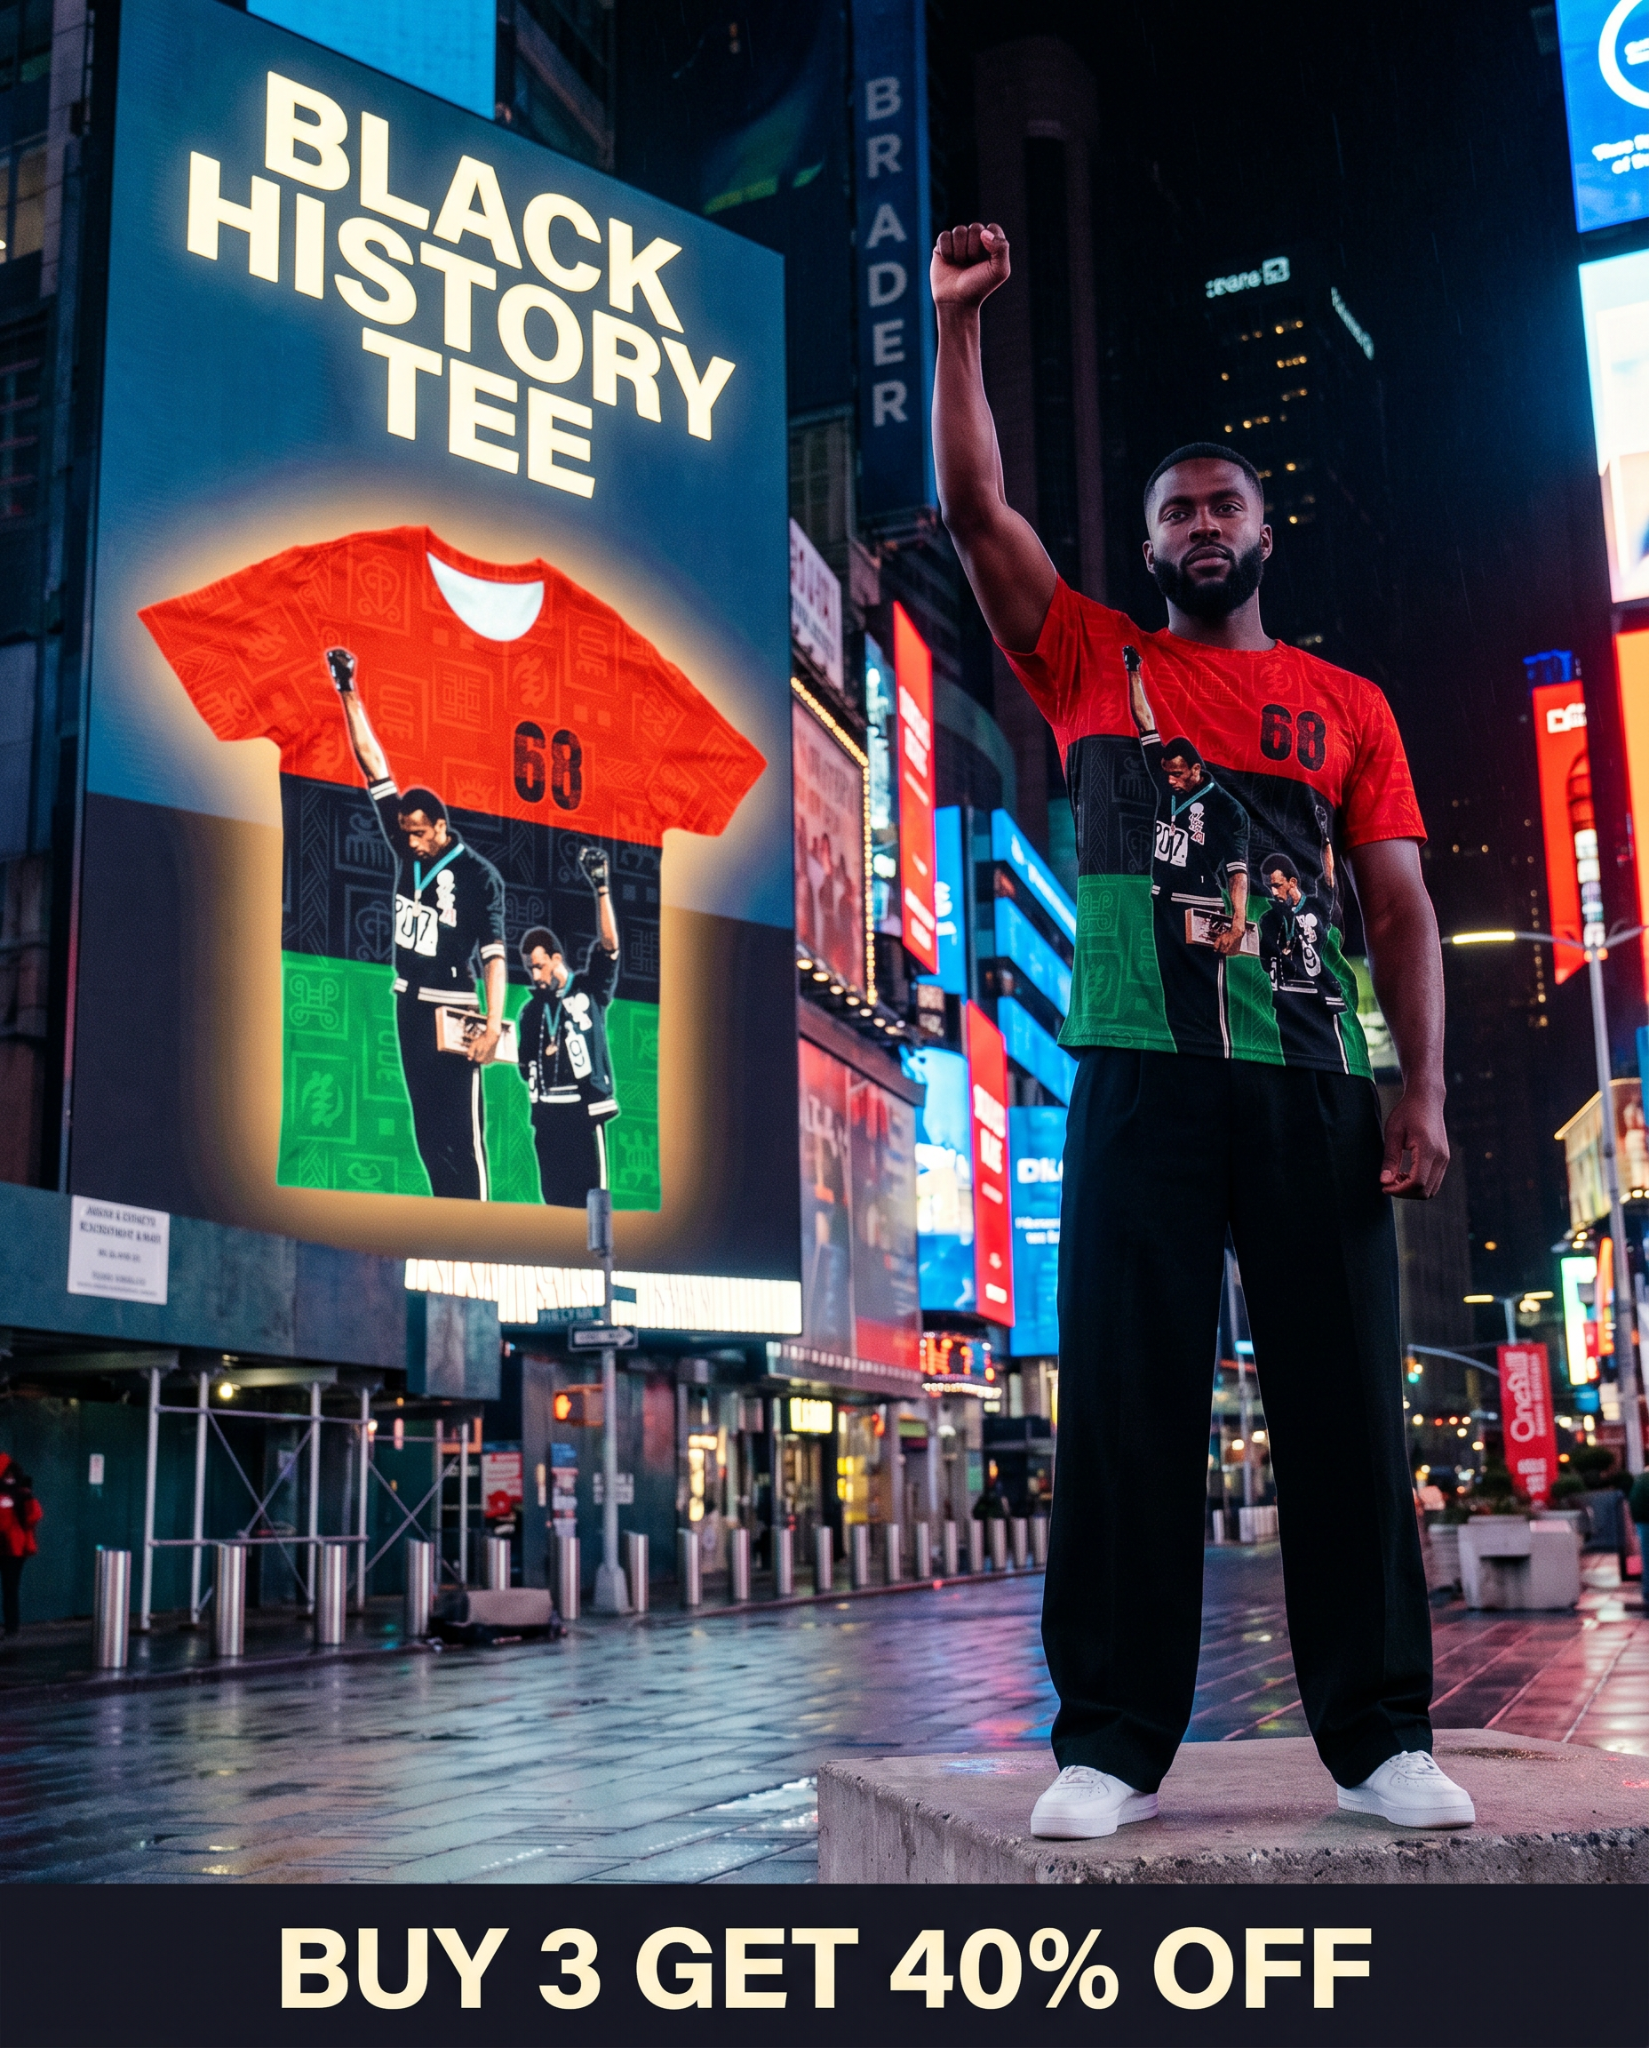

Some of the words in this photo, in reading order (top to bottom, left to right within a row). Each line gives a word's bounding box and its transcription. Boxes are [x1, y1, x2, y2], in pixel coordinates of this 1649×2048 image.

[188, 151, 735, 440] HISTORY
[266, 71, 684, 333] BLACK
[865, 76, 908, 427] BRADER
[363, 327, 595, 498] TEE
[514, 721, 583, 811] 68
[1260, 703, 1326, 772] 68
